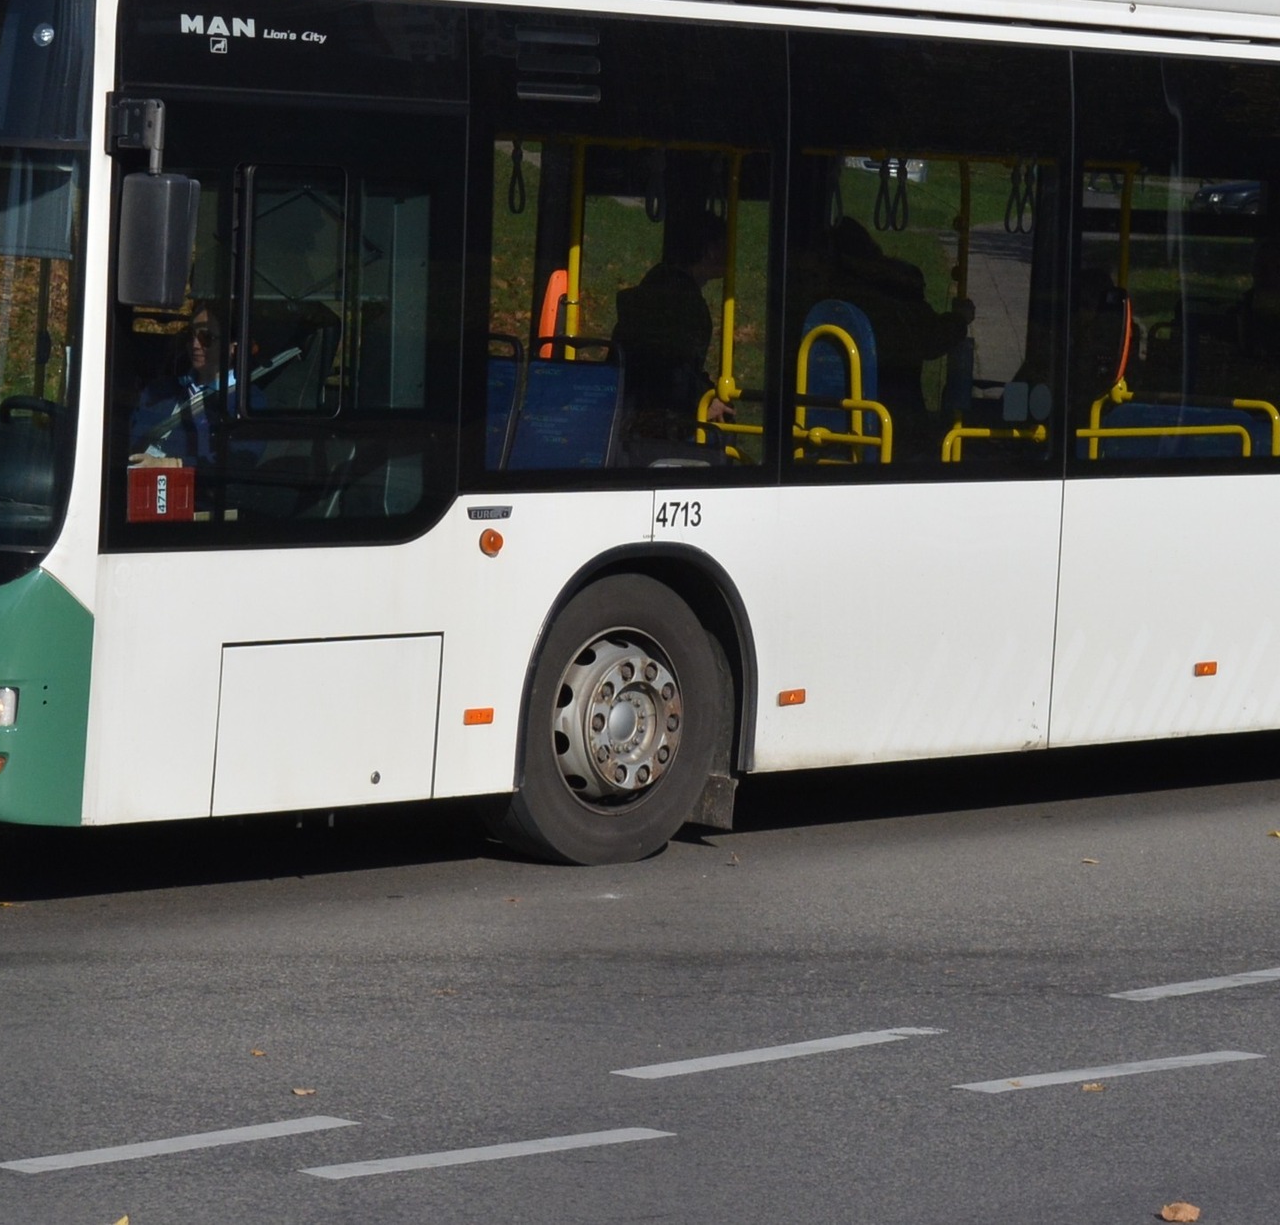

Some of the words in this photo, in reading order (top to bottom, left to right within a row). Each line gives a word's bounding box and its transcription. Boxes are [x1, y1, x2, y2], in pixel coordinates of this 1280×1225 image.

[181, 14, 256, 38] MAN
[263, 29, 297, 41] Lion's
[301, 31, 327, 44] City
[158, 478, 166, 512] 4713
[655, 501, 702, 528] 4713
